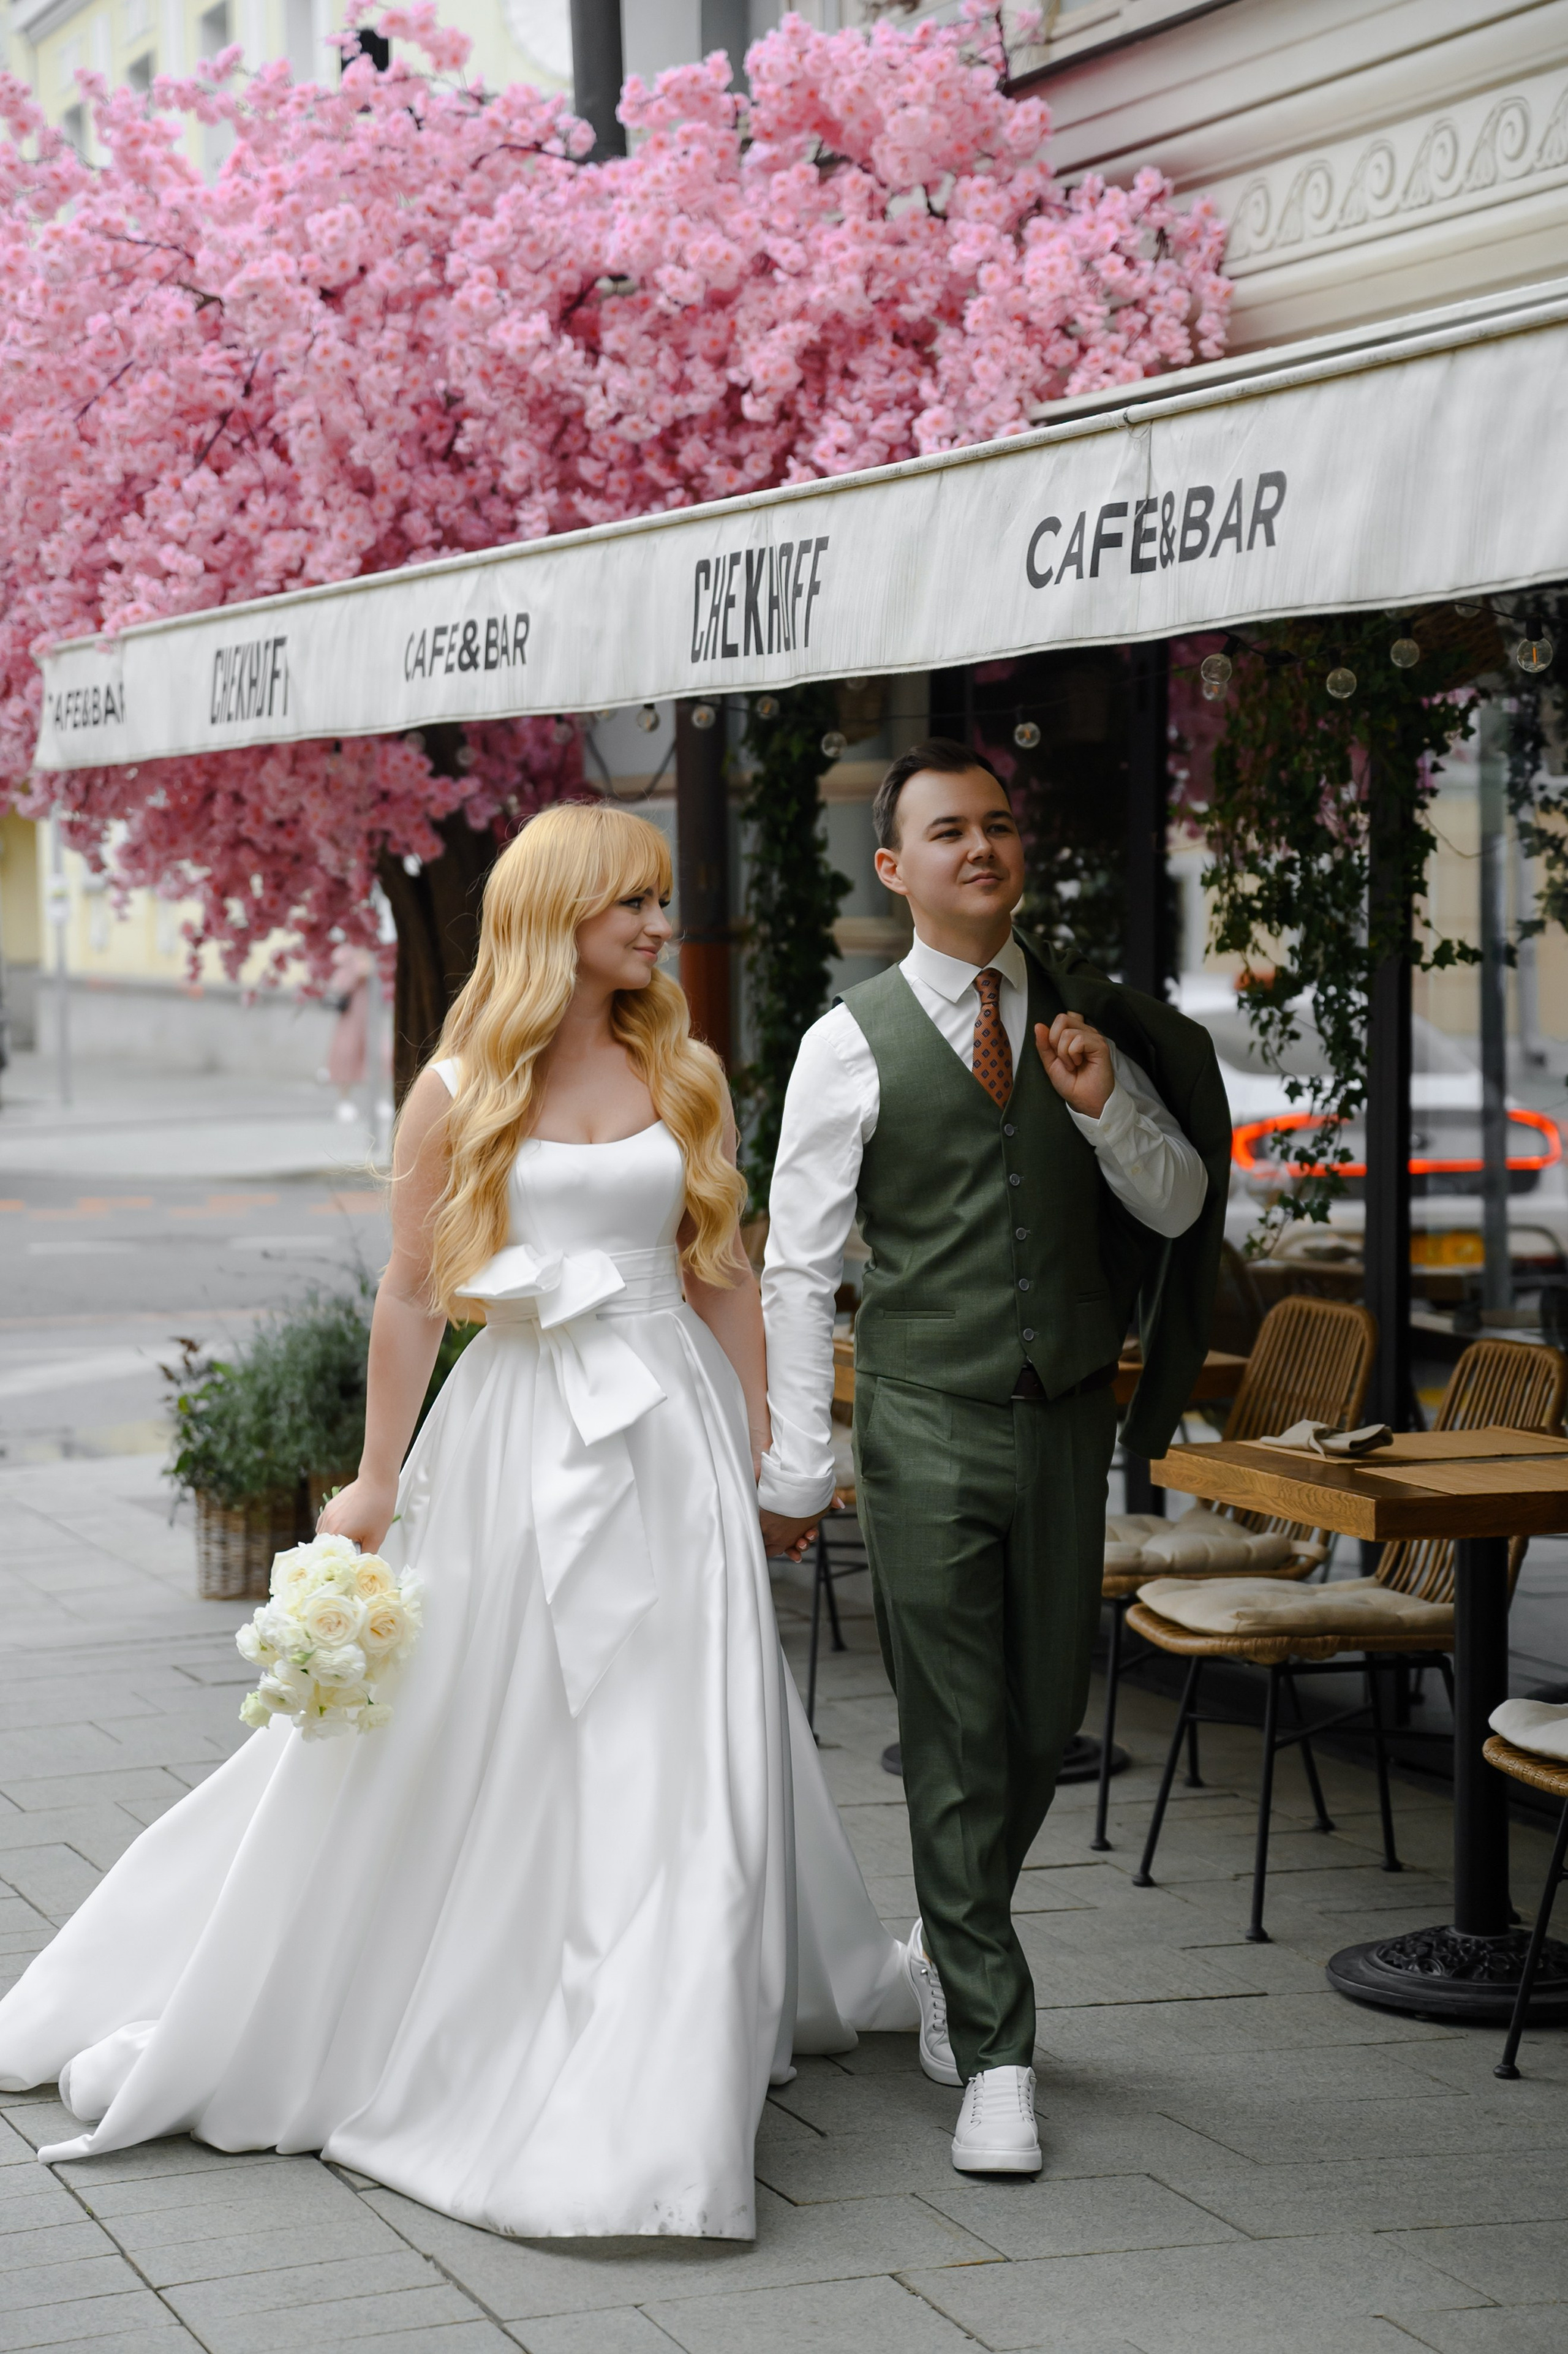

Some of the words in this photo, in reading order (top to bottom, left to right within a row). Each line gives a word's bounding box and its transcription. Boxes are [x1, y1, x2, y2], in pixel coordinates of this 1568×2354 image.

[48, 681, 126, 731] AFE&BA
[404, 612, 530, 682] CAFE&BAR
[691, 535, 830, 663] CHEKHOFF
[1026, 470, 1287, 589] CAFE&BAR
